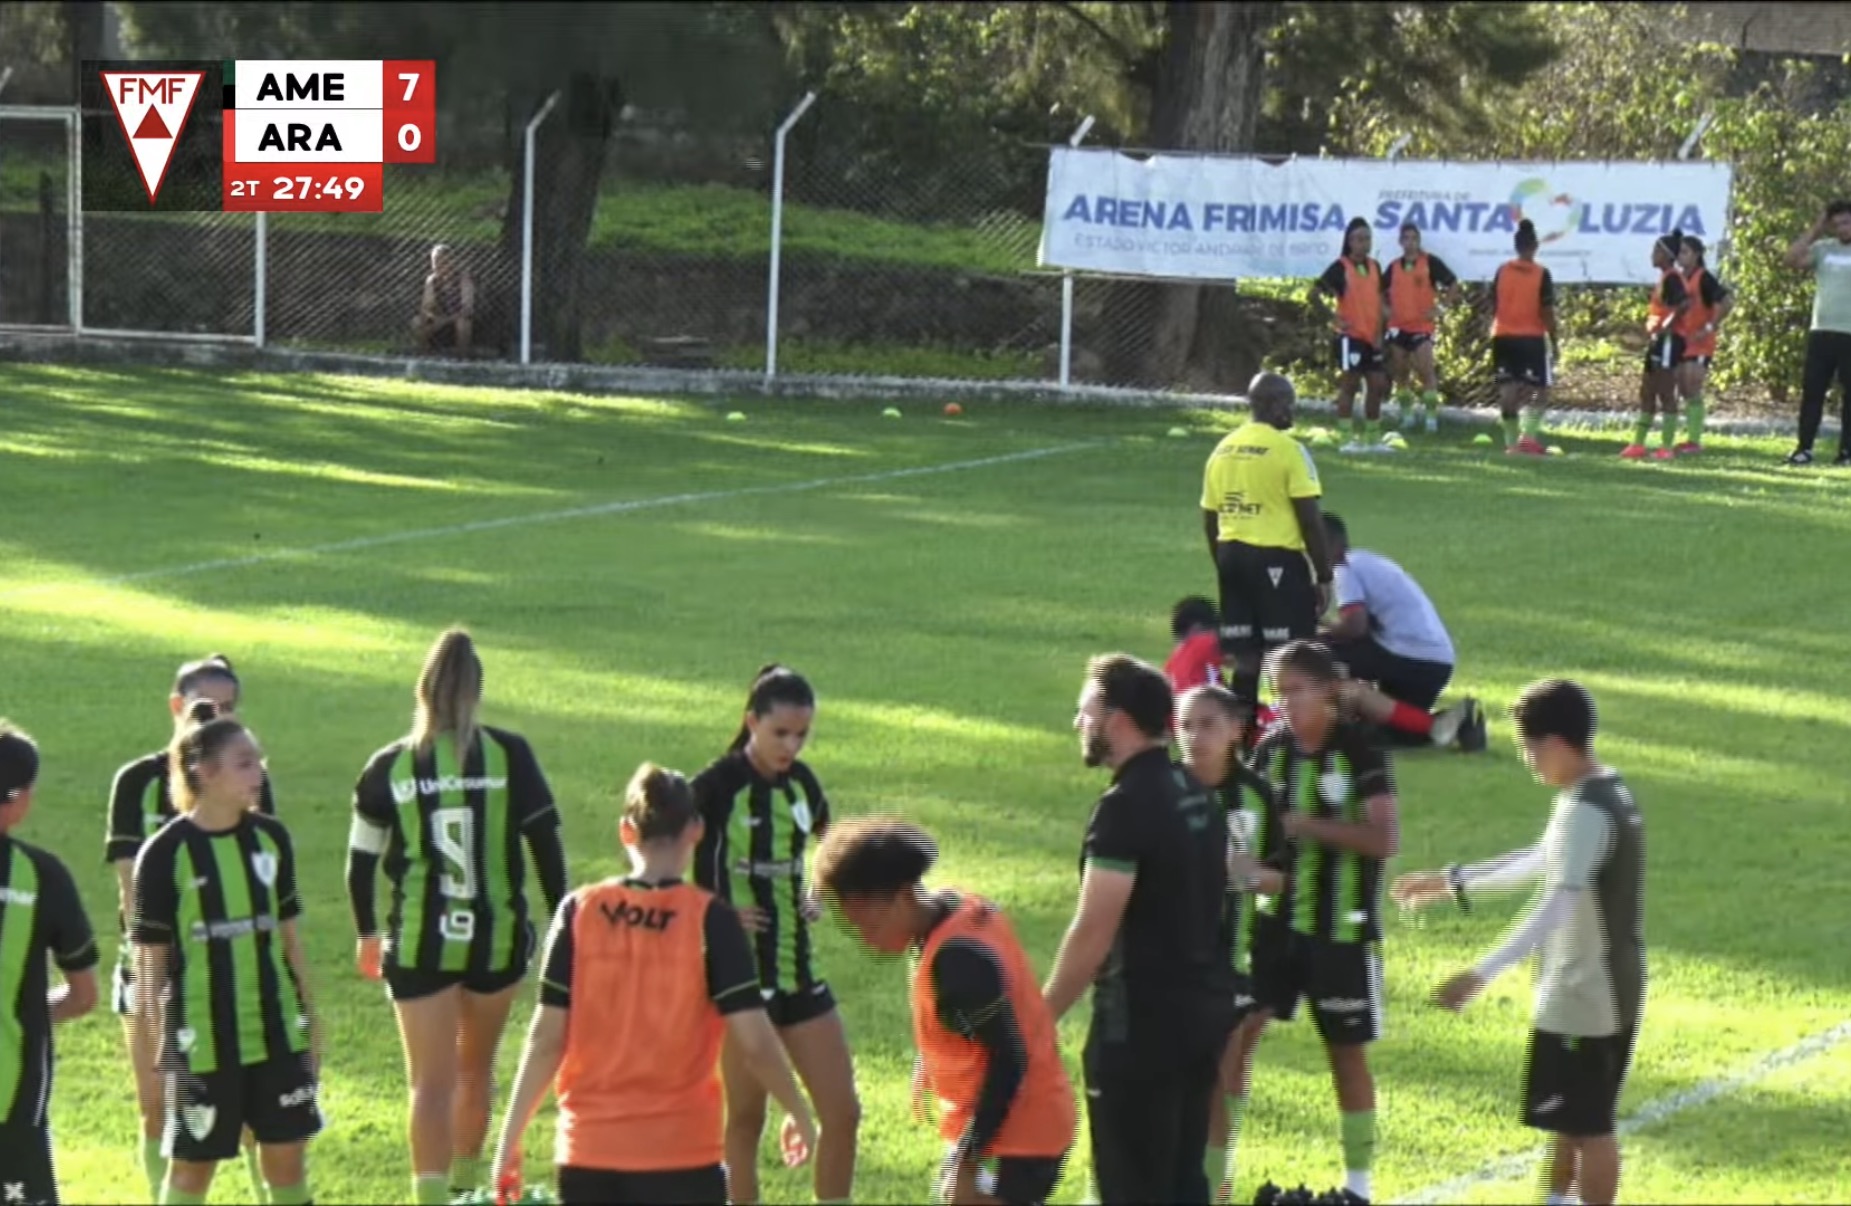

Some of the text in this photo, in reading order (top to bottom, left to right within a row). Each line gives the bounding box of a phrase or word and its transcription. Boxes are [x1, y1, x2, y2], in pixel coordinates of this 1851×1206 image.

[1062, 195, 1345, 232] ARENA FRIMISA
[1374, 202, 1706, 236] SANTA LUZIA
[600, 900, 676, 932] VOLT
